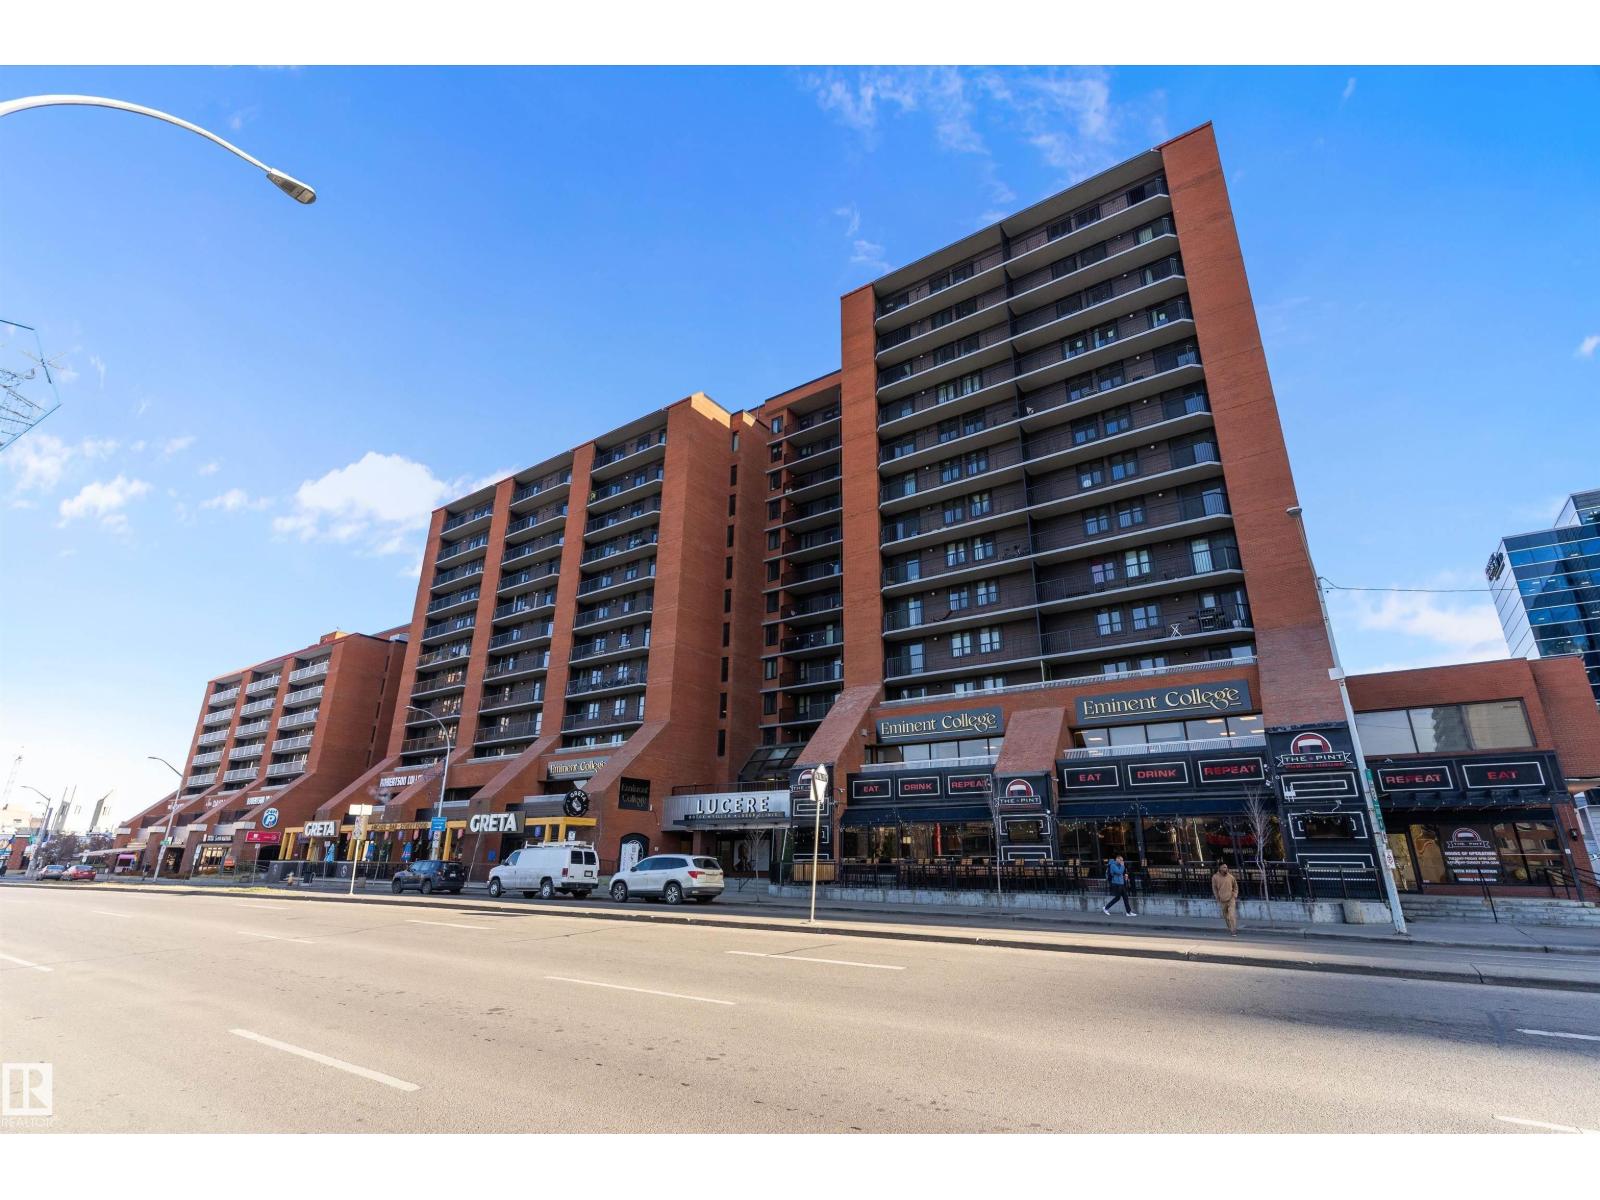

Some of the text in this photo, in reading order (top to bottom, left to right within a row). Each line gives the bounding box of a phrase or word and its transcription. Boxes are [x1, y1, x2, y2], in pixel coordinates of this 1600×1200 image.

[1083, 687, 1240, 716] Eminent College
[881, 713, 996, 735] Eminent College
[1315, 753, 1343, 761] PINT
[1137, 769, 1177, 779] DRINK
[1203, 764, 1257, 776] REPEAT
[1487, 770, 1518, 780] EAT
[1079, 773, 1102, 782] EAT
[1385, 774, 1441, 784] REPEAT
[863, 785, 880, 793] EAT
[903, 783, 933, 791] DRINK
[951, 779, 989, 789] REPEAT
[570, 790, 587, 802] GRETA
[696, 796, 770, 814] LUCERE
[469, 812, 517, 833] GRETA
[304, 821, 336, 837] GRETA
